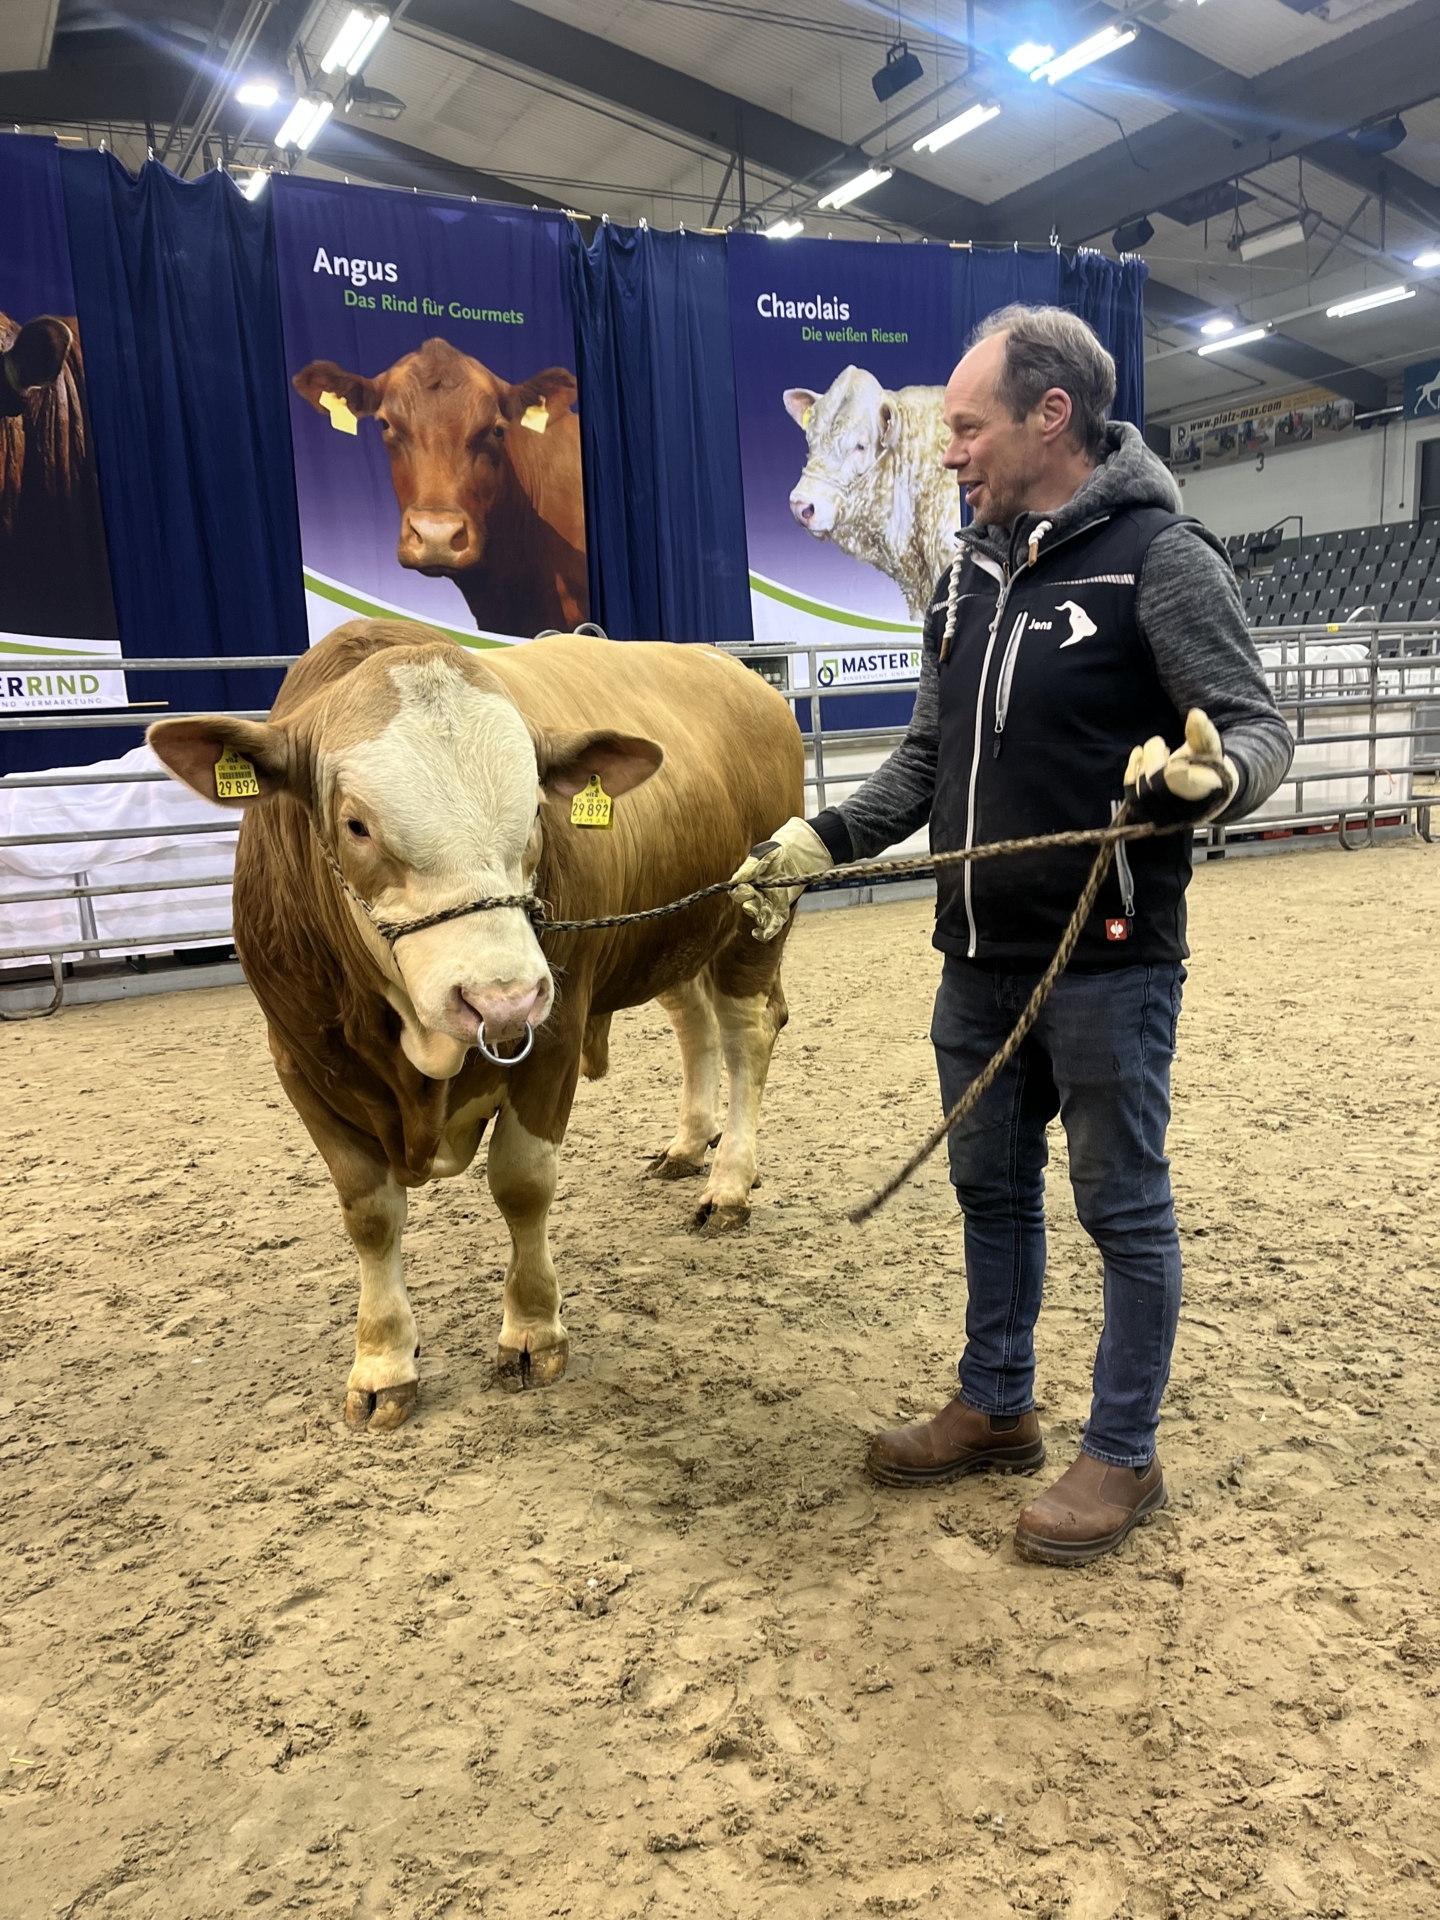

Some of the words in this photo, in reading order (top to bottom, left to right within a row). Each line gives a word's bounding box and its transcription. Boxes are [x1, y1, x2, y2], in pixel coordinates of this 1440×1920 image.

[313, 247, 398, 286] Angus
[344, 290, 376, 309] Das
[381, 294, 418, 314] Rind
[422, 298, 444, 317] für
[448, 302, 524, 324] Gourmets
[757, 292, 850, 321] Charolais
[801, 326, 822, 341] Die
[825, 326, 867, 342] weißen
[872, 328, 908, 343] Riesen
[1189, 400, 1282, 432] www.platz-max.com
[1255, 452, 1265, 472] 3
[25, 697, 102, 707] VERMARKTUNG
[219, 781, 232, 796] 29
[235, 779, 258, 794] 892
[572, 802, 585, 817] 29
[587, 803, 609, 817] 892
